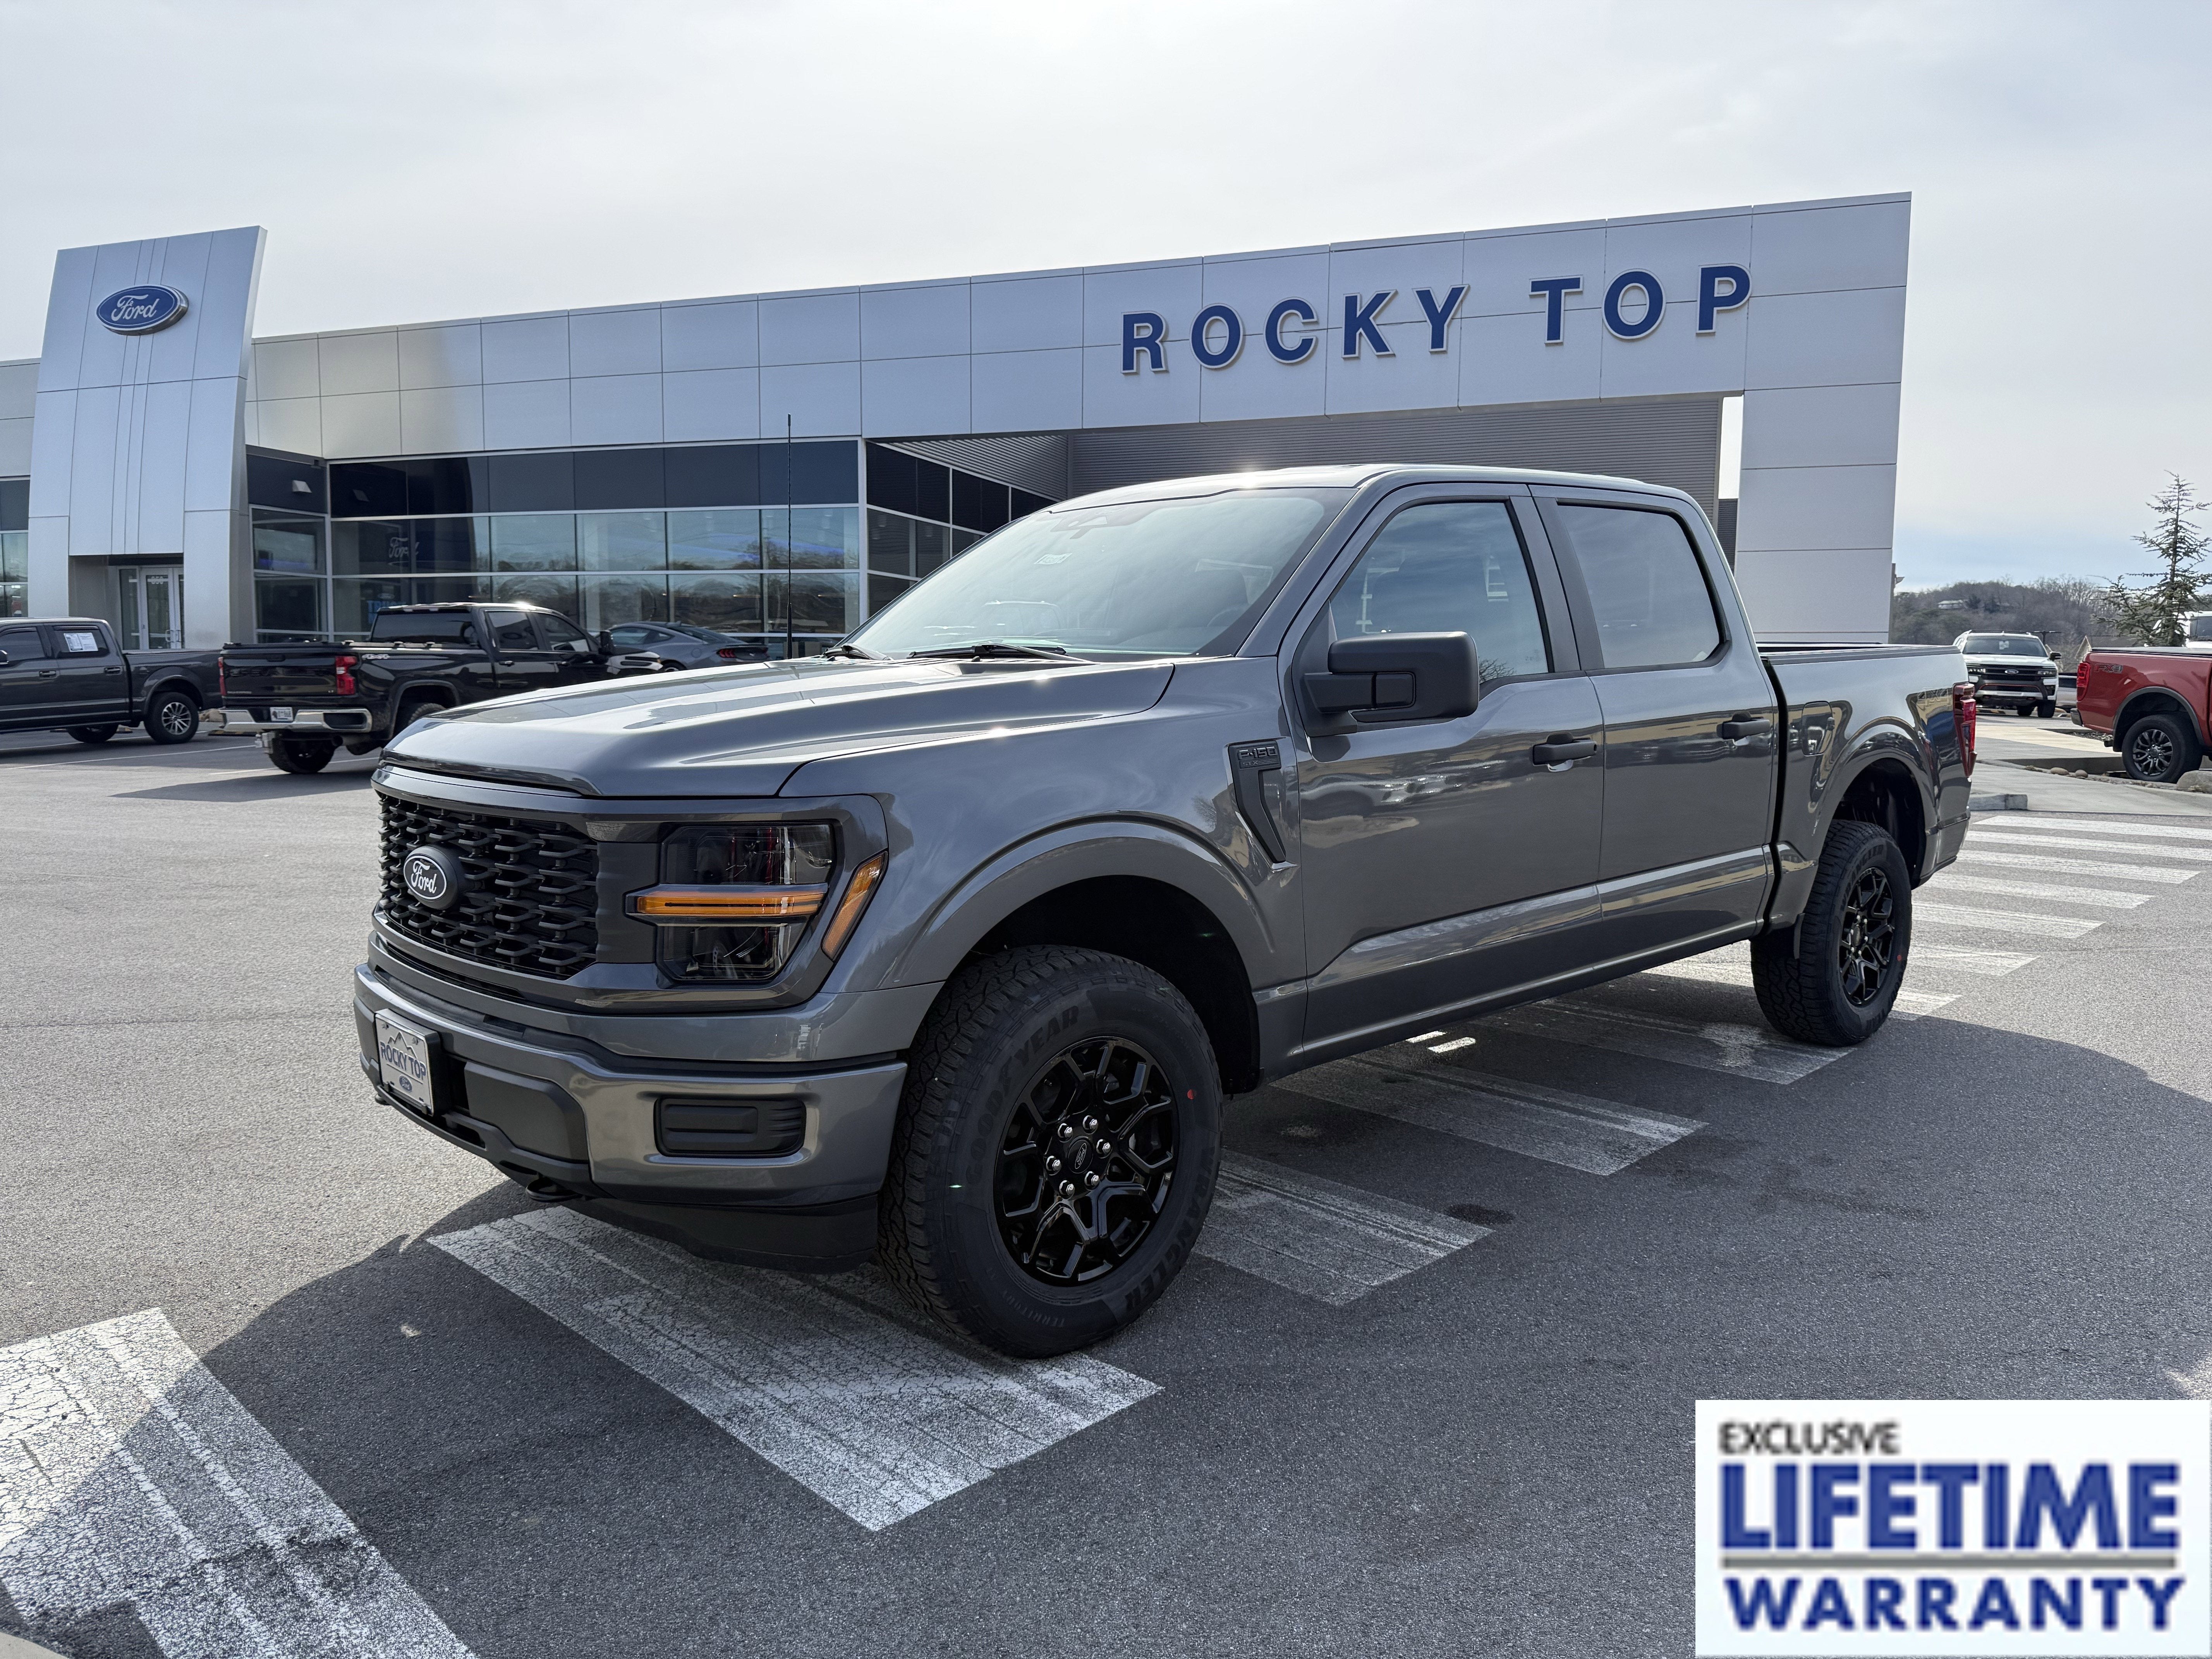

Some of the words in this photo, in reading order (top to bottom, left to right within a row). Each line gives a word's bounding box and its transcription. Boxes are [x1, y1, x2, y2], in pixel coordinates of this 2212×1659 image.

[111, 294, 160, 321] Ford
[1121, 284, 1470, 374] ROCKY
[1530, 263, 1752, 345] TOP
[1238, 746, 1278, 761] F-150
[410, 860, 437, 894] Ford
[380, 1041, 407, 1071] ROCKY
[408, 1056, 426, 1081] TOP
[965, 1005, 1079, 1185] GOODYEAR
[1124, 1146, 1215, 1312] WRANGLER
